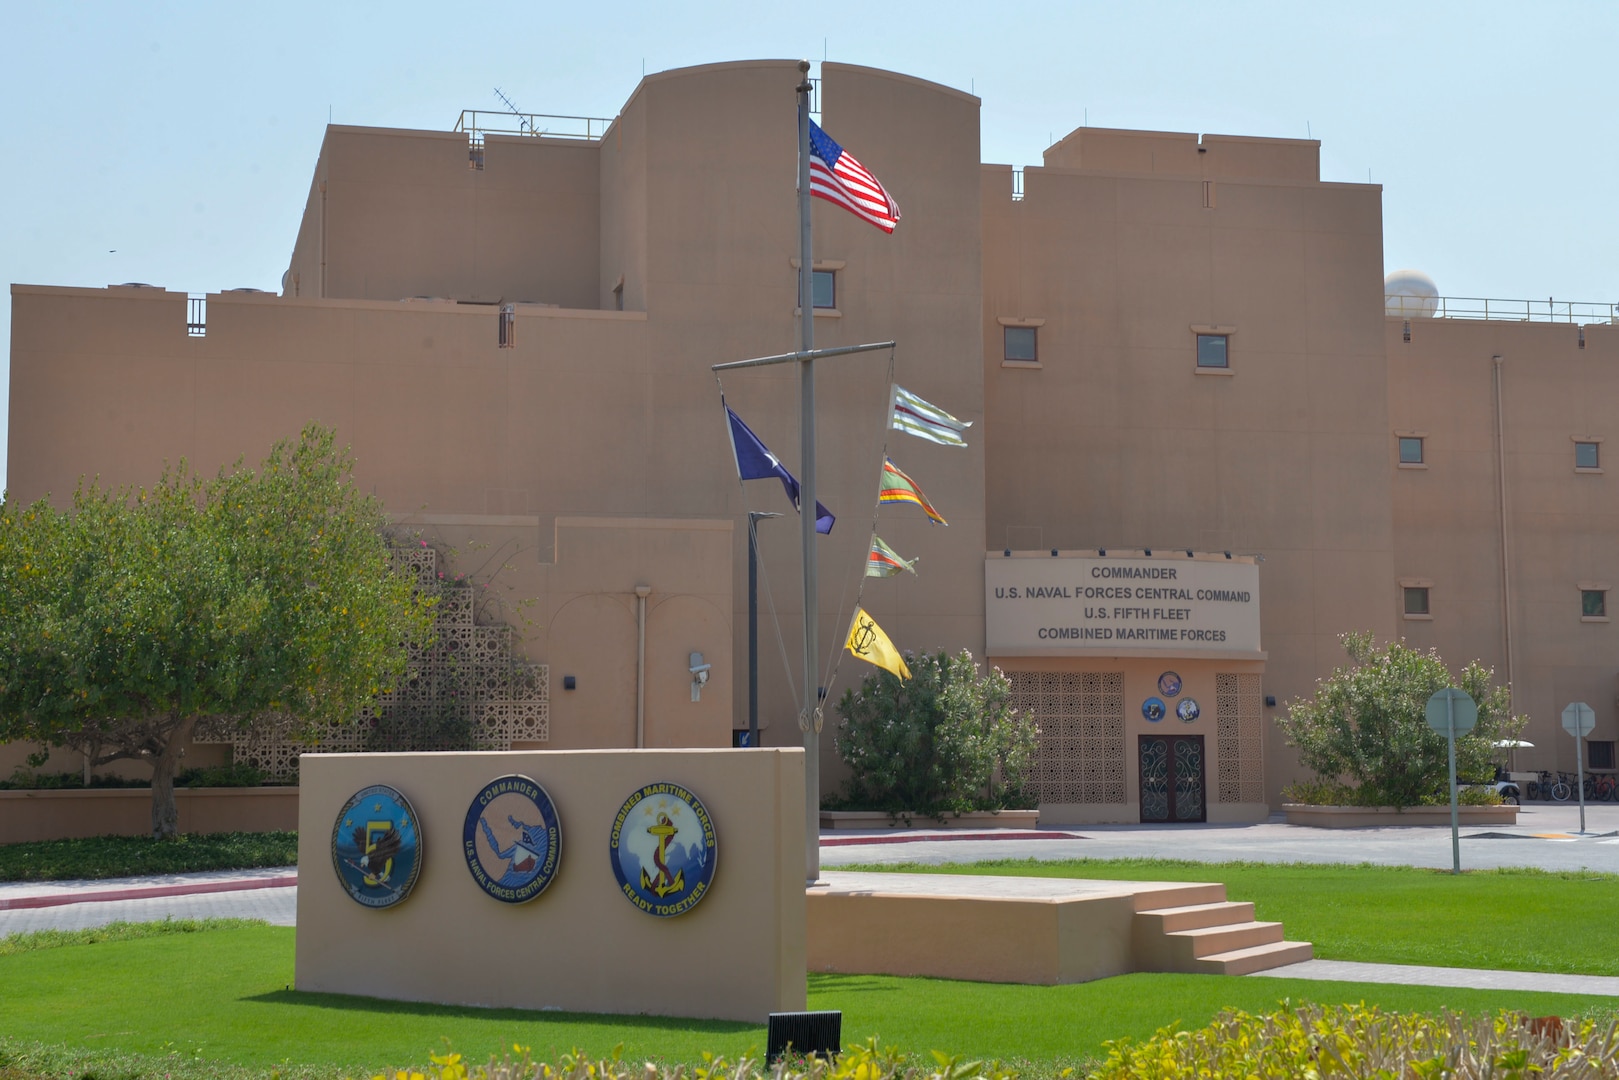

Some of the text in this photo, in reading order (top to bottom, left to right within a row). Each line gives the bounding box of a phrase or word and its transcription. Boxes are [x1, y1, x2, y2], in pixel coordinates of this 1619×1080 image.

[1091, 567, 1178, 580] COMMANDER
[995, 586, 1251, 603] U.S. NAVAL FORCES CENTRAL COMMAND
[1084, 607, 1191, 620] U.S. FIFTH FLEET
[1038, 627, 1226, 642] COMBINED MARITIME FORCES
[480, 781, 538, 806] COMMANDER
[611, 783, 715, 848] COMBINED MARITIME FORCES
[470, 859, 487, 886] NAVAL
[486, 882, 515, 899] FORCES
[515, 874, 547, 898] CENTRAL
[543, 826, 557, 874] COMMAND
[623, 881, 706, 915] READY TOGETHER
